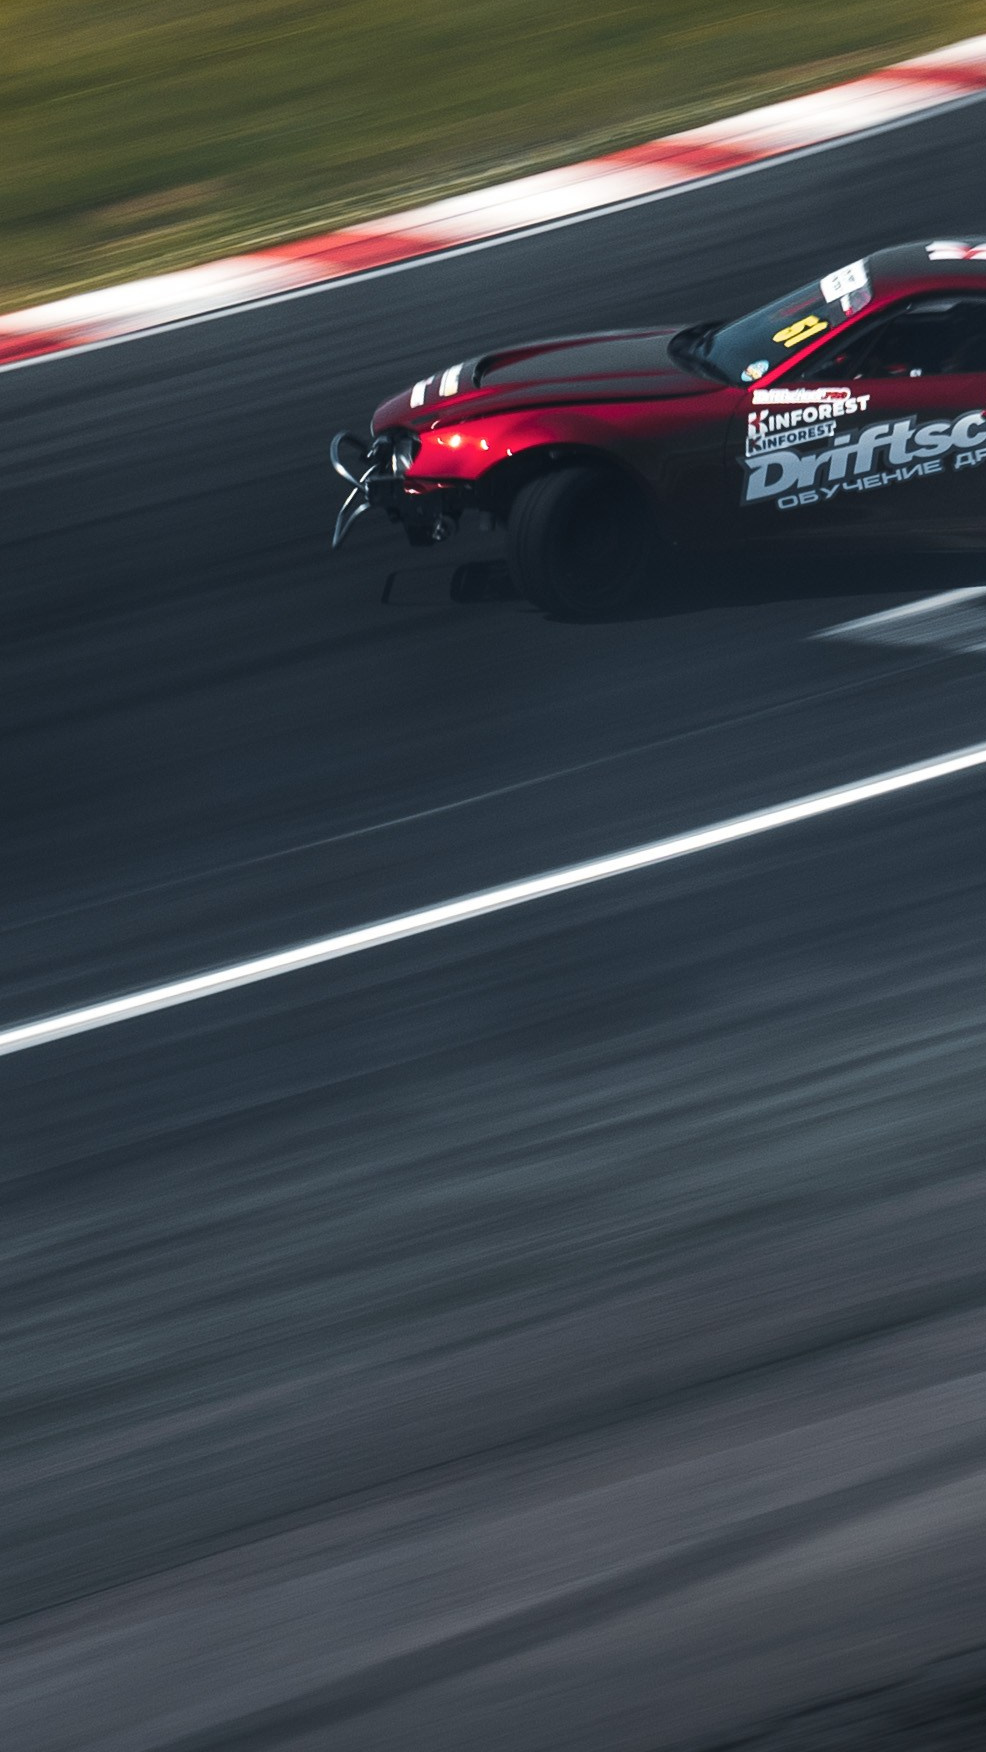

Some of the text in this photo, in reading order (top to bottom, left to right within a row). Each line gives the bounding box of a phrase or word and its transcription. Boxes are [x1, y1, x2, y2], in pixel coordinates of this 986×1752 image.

[772, 314, 829, 348] 51
[747, 394, 871, 438] KINFOREST
[747, 422, 835, 454] KINFOREST
[777, 459, 943, 510] ОБУЧЕНИЕ
